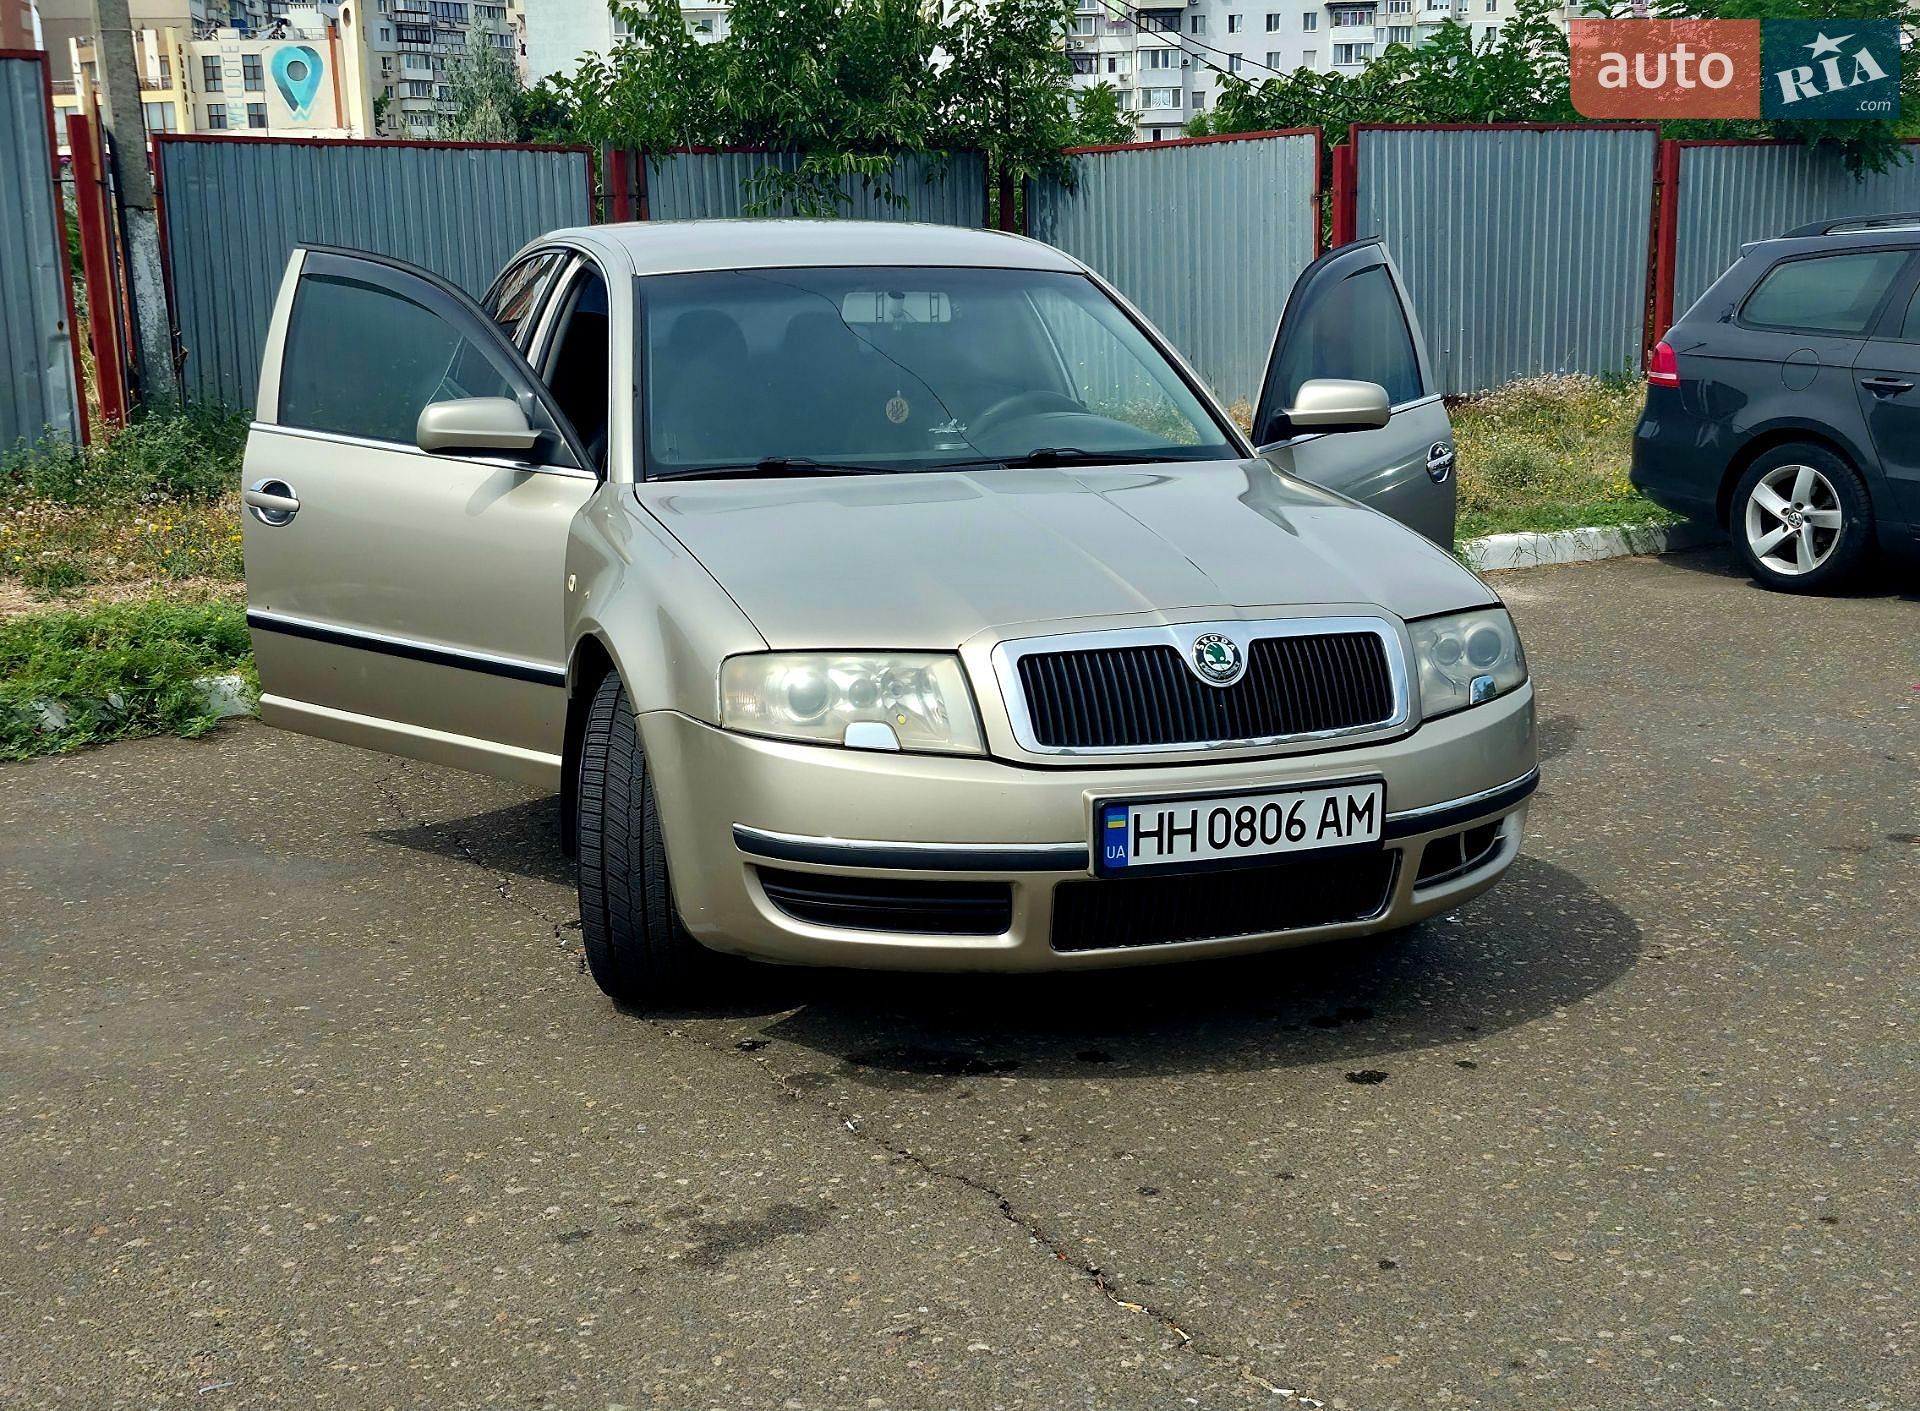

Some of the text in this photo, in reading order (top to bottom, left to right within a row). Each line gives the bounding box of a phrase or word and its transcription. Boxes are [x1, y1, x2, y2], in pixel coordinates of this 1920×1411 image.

[1132, 792, 1375, 857] HH 0806 AM
[1106, 845, 1126, 859] UA
